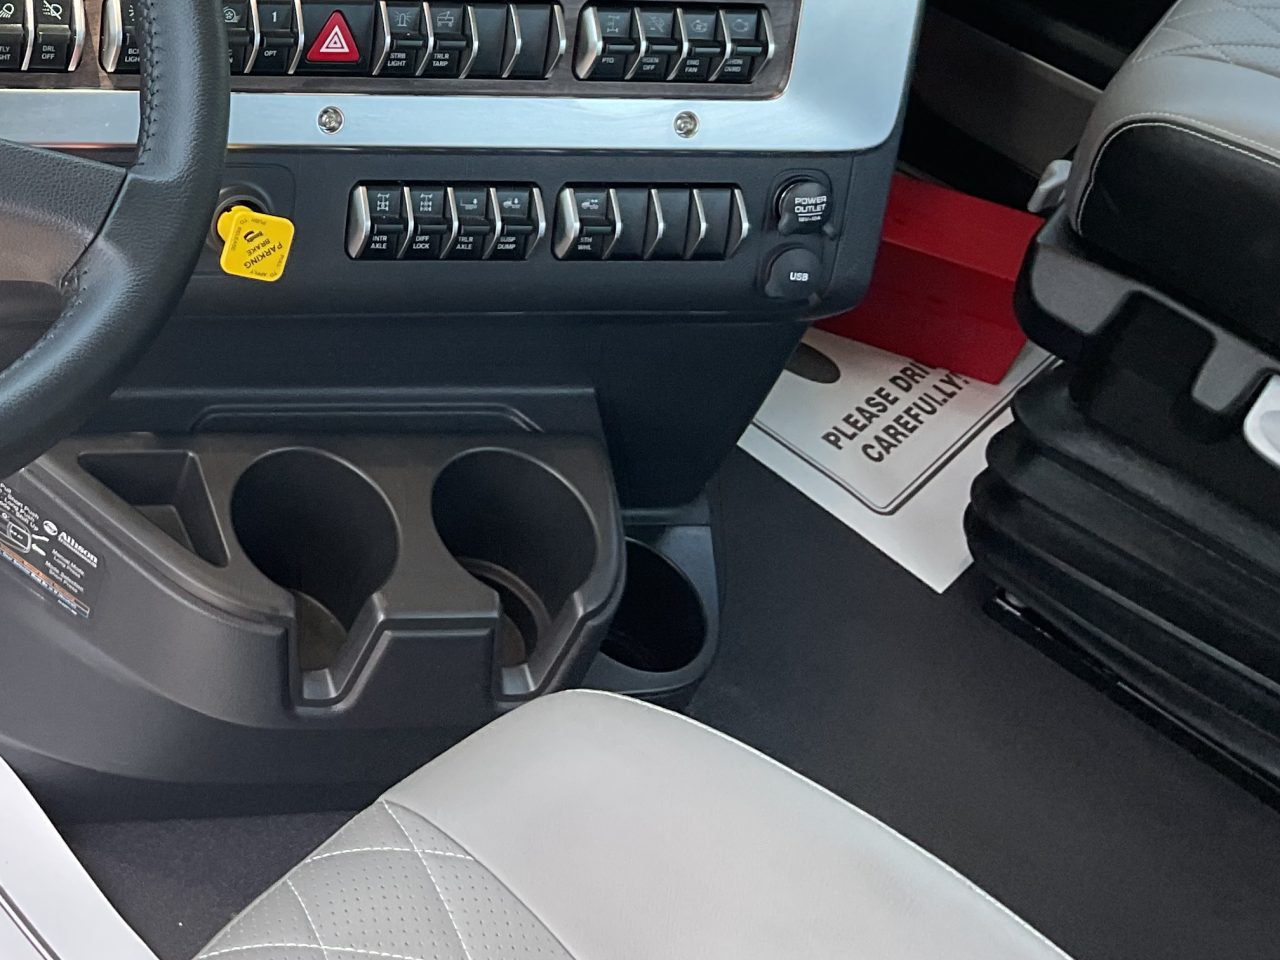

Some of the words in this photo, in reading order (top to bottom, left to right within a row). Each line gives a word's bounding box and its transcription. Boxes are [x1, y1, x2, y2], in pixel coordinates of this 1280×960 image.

[795, 195, 827, 204] POWER
[795, 203, 826, 213] OUTLET
[243, 241, 283, 269] PARKING
[246, 238, 271, 257] BRAKE
[790, 271, 809, 282] USB
[821, 386, 900, 450] PLEASE
[888, 361, 931, 393] DRI
[58, 531, 98, 563] Allison
